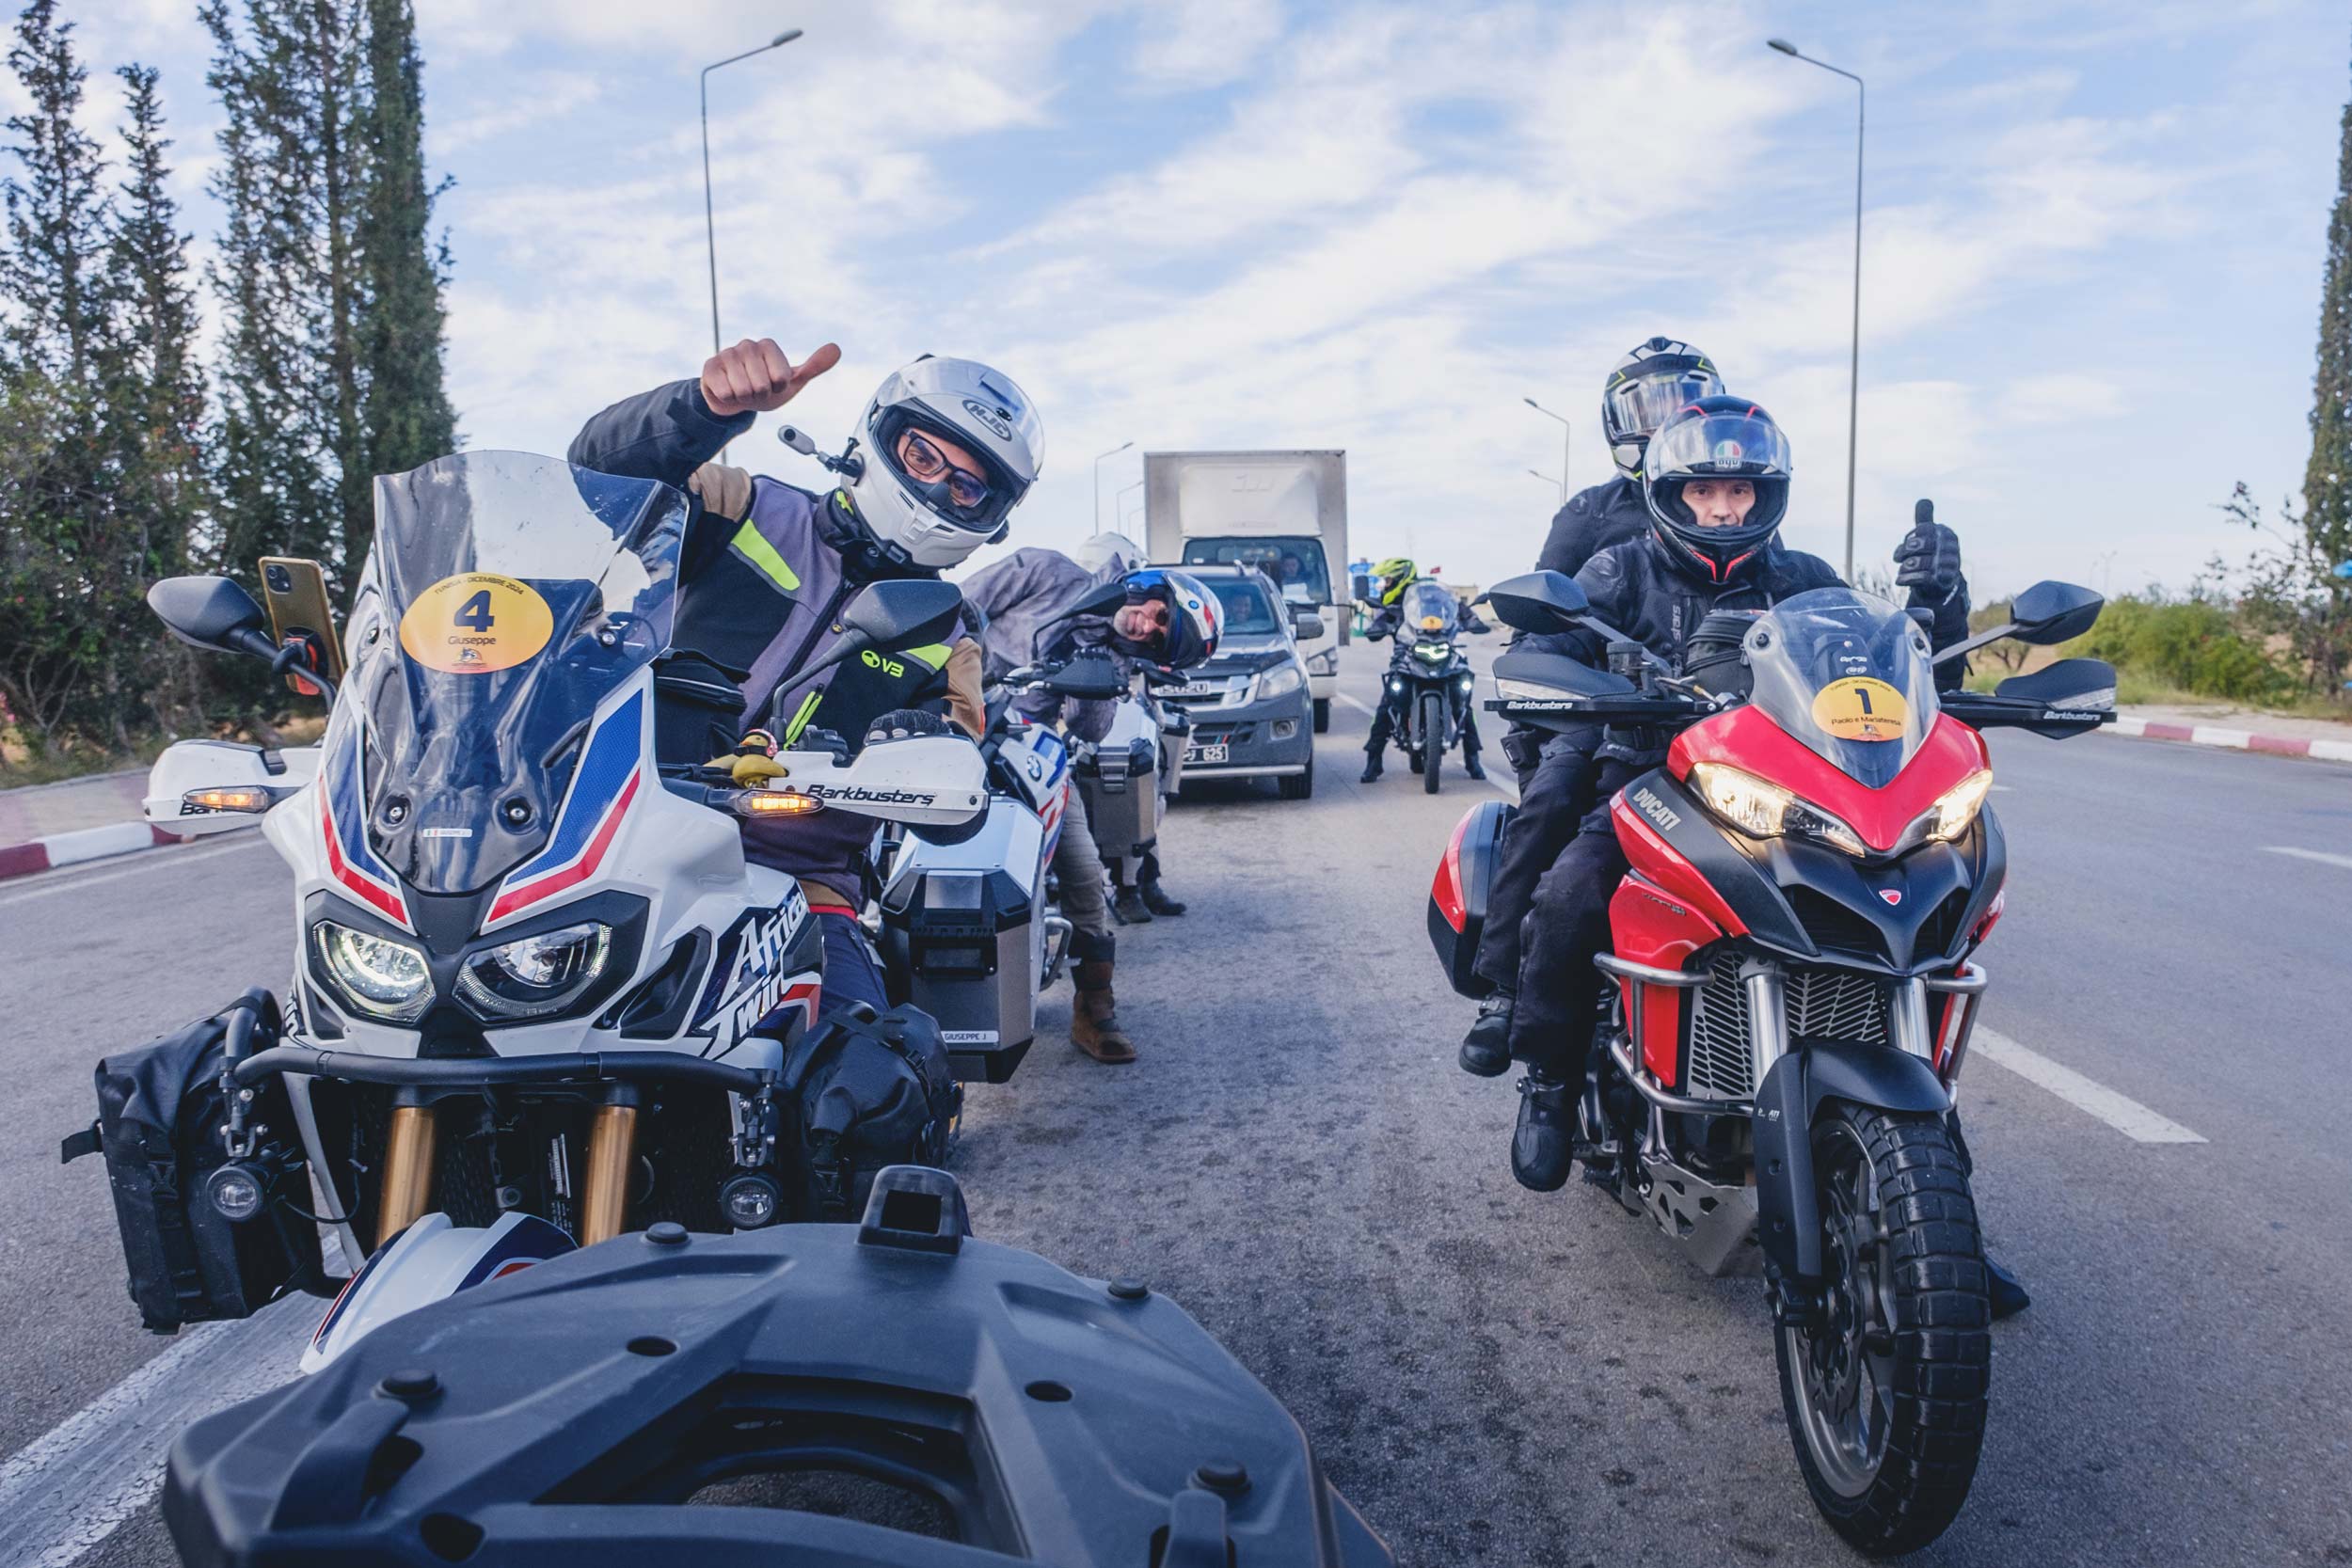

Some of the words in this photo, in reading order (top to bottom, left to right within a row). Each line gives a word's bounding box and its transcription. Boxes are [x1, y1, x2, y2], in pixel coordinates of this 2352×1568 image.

[969, 404, 1009, 436] HJC
[453, 590, 495, 632] 4
[448, 635, 497, 646] Giuseppe
[1159, 683, 1208, 694] ISUZU
[1506, 701, 1574, 710] Barkbusters
[1854, 688, 1873, 715] 1
[2042, 710, 2102, 721] Barkbusters
[1203, 747, 1223, 761] 625
[806, 784, 937, 806] Barkbusters
[1632, 786, 1682, 832] DUCATI
[717, 892, 808, 1010] Africa
